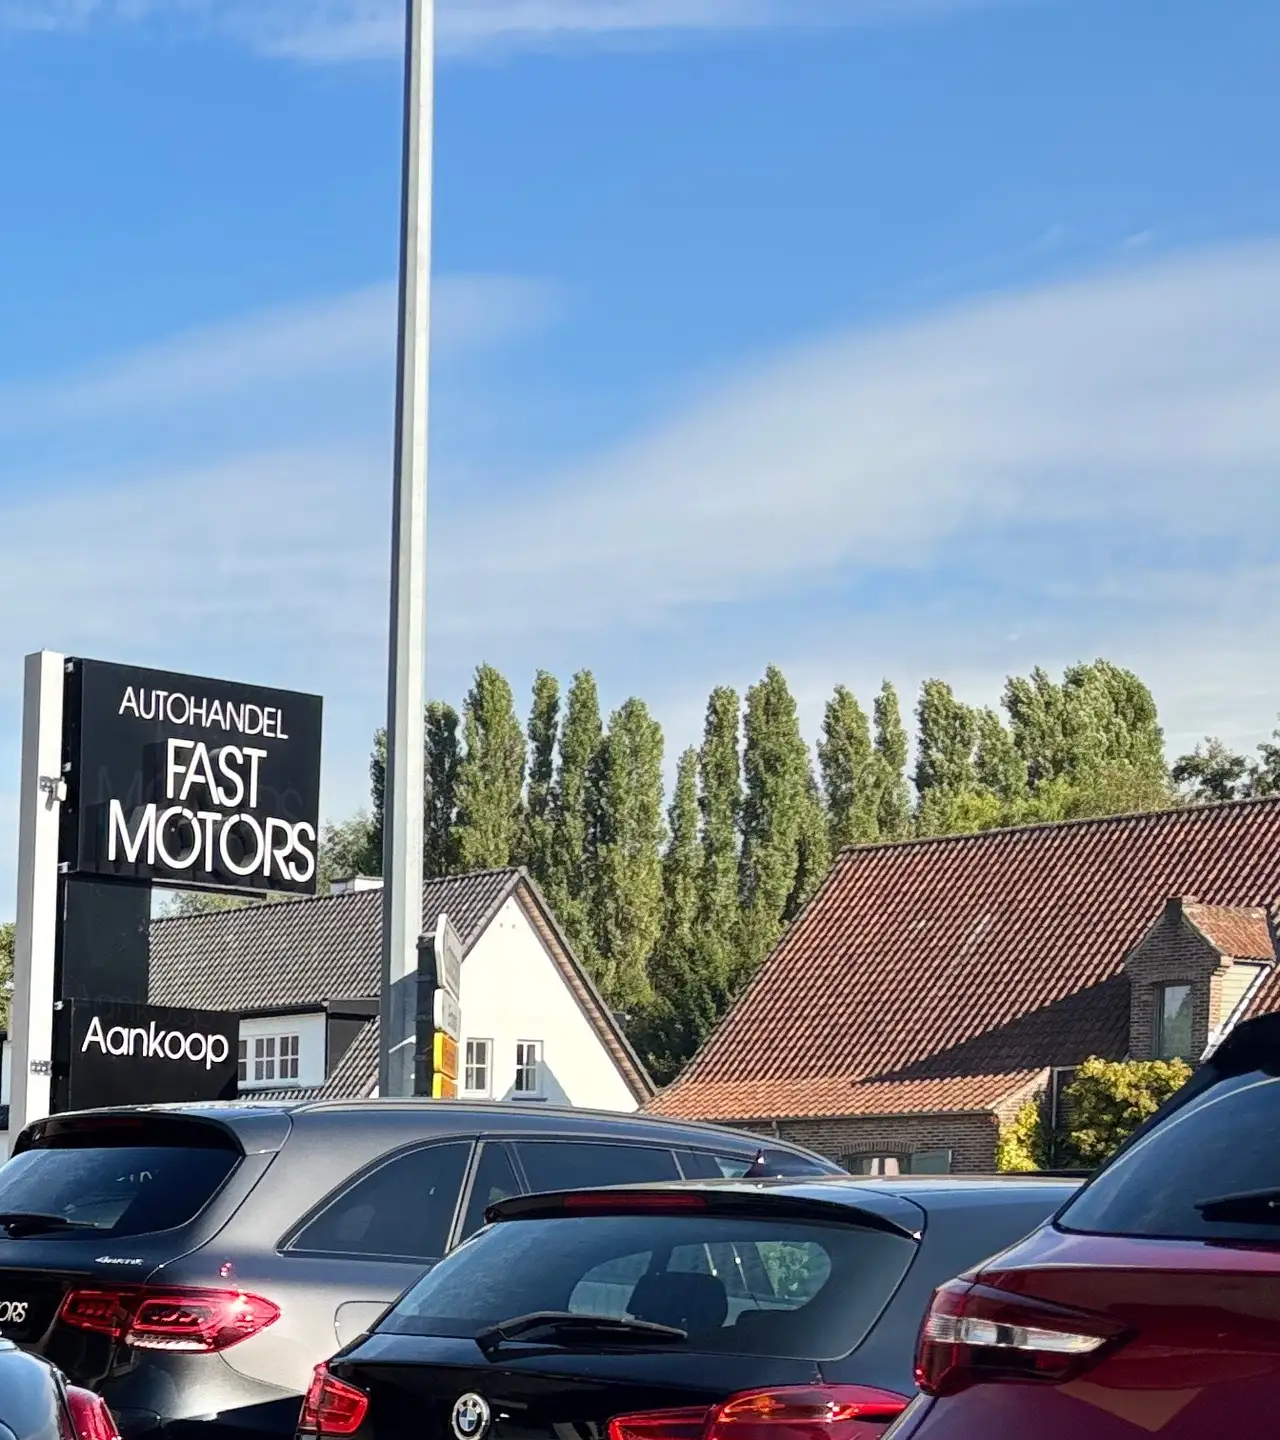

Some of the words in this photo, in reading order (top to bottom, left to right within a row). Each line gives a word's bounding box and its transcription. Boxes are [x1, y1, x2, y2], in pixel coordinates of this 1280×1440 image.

[119, 686, 288, 740] AUTOHANDEL
[166, 738, 267, 808] FAST
[108, 799, 315, 882] MOTORS
[81, 1016, 229, 1070] Aankoop
